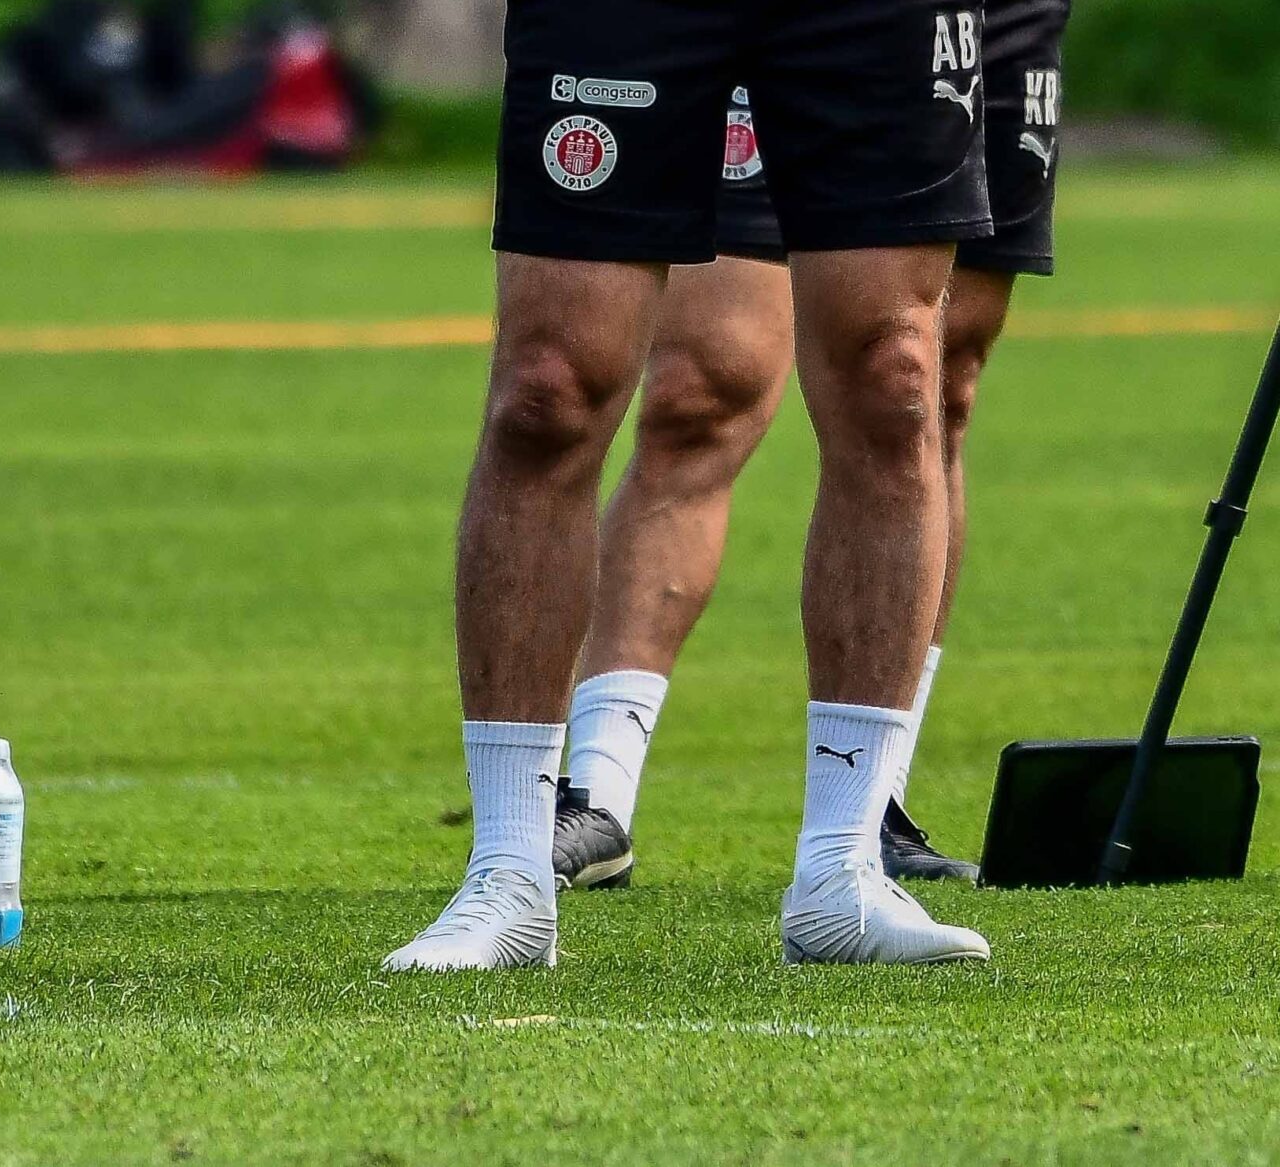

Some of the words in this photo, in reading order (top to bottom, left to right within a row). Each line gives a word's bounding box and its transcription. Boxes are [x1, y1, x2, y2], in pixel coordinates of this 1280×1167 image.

[932, 12, 976, 72] AB
[584, 86, 649, 101] congstar
[546, 132, 560, 148] FC
[559, 119, 578, 133] ST.
[582, 118, 615, 154] PAULI
[723, 166, 747, 178] 910
[561, 175, 592, 190] 1910
